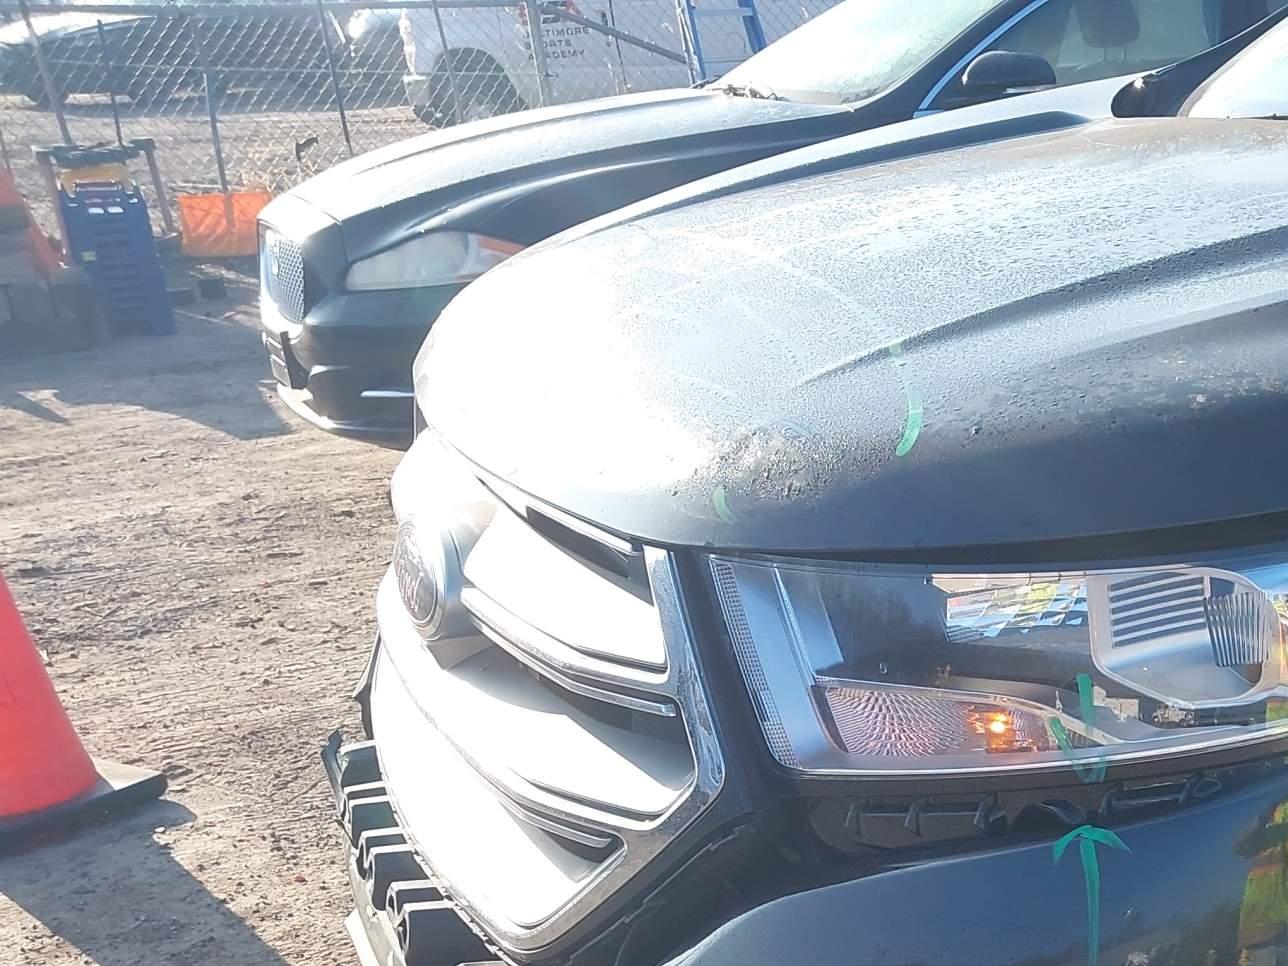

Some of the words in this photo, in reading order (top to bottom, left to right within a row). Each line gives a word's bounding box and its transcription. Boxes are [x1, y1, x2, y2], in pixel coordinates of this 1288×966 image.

[522, 27, 590, 38] TIMORE
[524, 39, 572, 50] SORTS
[528, 50, 585, 60] AADEMY
